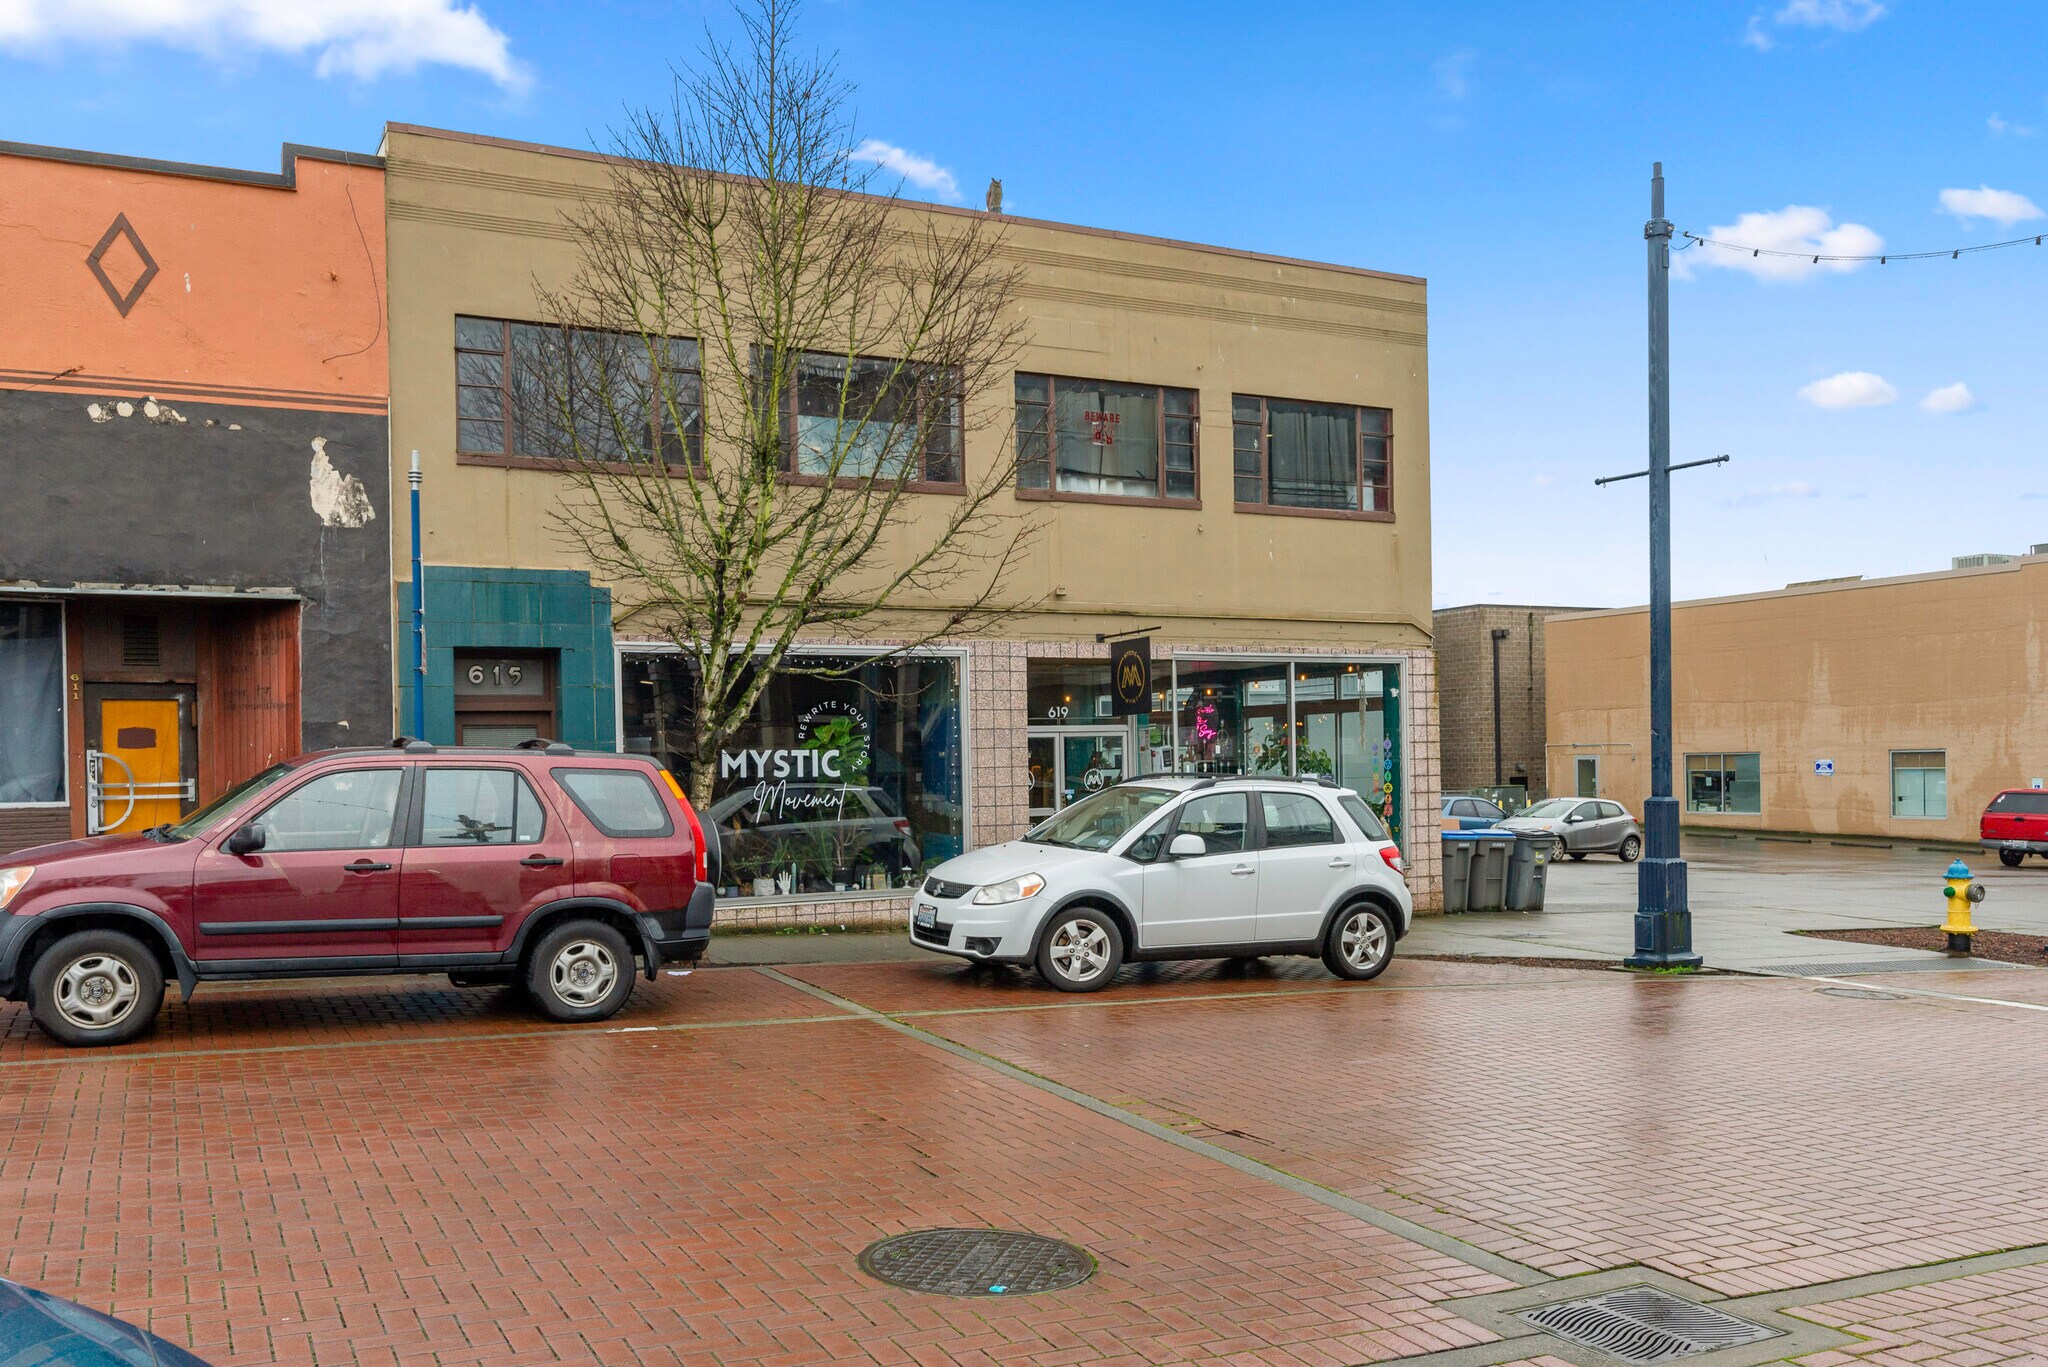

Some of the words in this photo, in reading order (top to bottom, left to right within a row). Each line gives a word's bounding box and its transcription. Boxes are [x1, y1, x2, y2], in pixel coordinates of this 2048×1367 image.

[1084, 410, 1121, 424] BEWARE
[70, 673, 80, 700] 611
[467, 665, 522, 685] 615
[798, 700, 837, 739] REWRITE
[842, 703, 868, 730] YOUR
[1048, 706, 1069, 718] 619
[721, 749, 841, 779] MYSTIC
[851, 735, 871, 772] STORY
[753, 779, 863, 824] Movement
